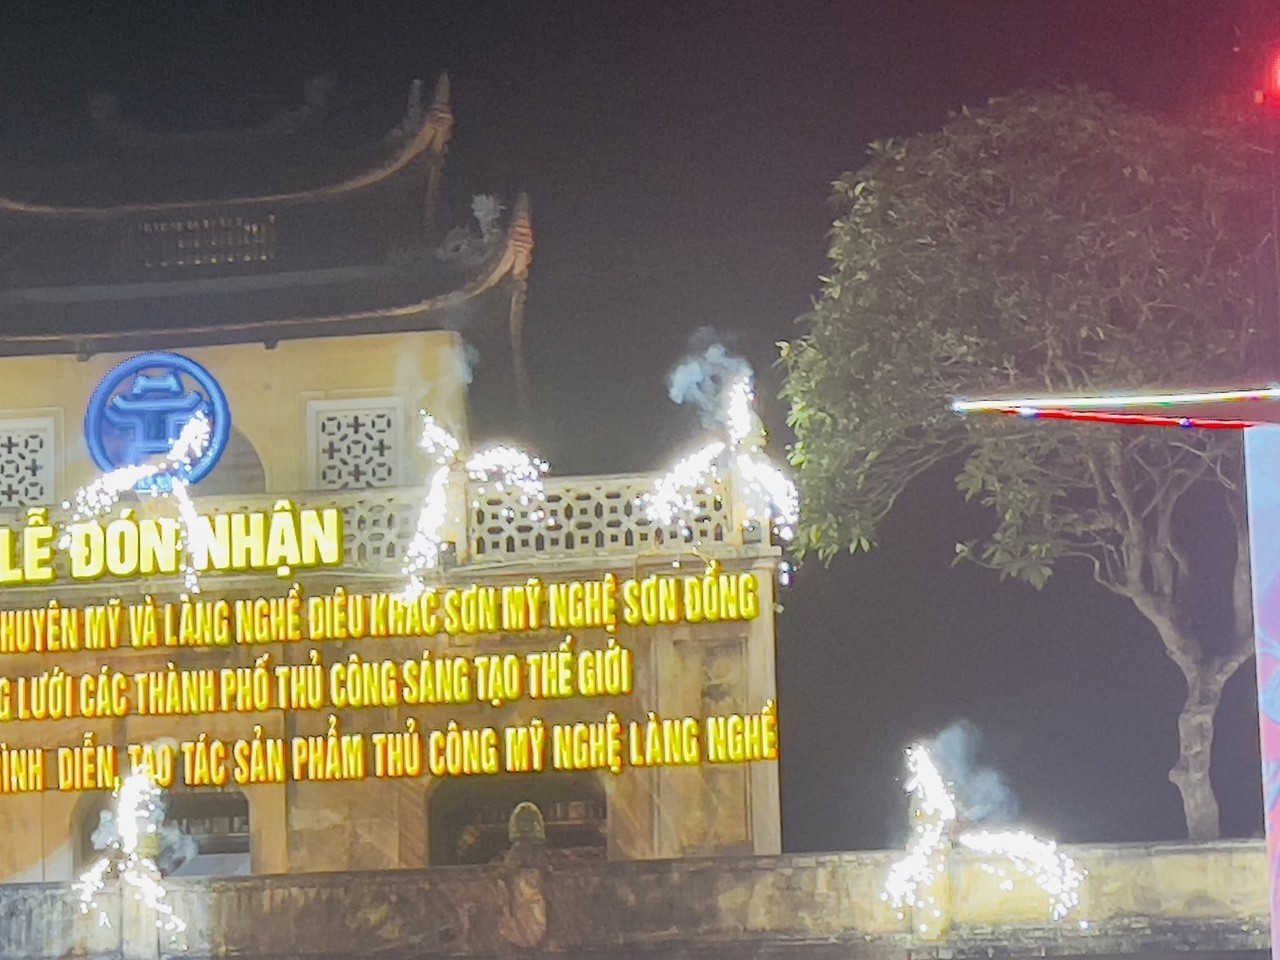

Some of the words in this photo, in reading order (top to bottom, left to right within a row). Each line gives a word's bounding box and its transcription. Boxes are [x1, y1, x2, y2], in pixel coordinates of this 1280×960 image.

[70, 508, 179, 579] ĐÓN
[193, 499, 342, 578] NHẬN
[84, 598, 121, 650] MỸ
[129, 594, 158, 649] VÀ
[164, 593, 232, 646] LÀNG
[444, 583, 497, 635] SƠN
[501, 577, 541, 631] MỸ
[549, 573, 617, 633] NGHỆ
[623, 574, 679, 626] SƠN
[18, 665, 73, 720] LƯỚI
[80, 665, 127, 720] CÁC
[134, 661, 215, 716] THÀNH
[220, 652, 270, 712] PHỐ
[275, 649, 323, 710] THỦ
[330, 654, 397, 708] CÔNG
[402, 650, 469, 704] SÁNG
[474, 654, 521, 707] TẠO
[526, 634, 573, 699] THẾ
[578, 638, 633, 696] GIỚI
[58, 732, 120, 798] DIỄN,
[181, 733, 226, 786] TÁC
[233, 725, 285, 784] SẢN
[292, 713, 364, 781] PHẨM
[372, 717, 420, 777] THỦ
[429, 720, 499, 776] CÔNG
[505, 718, 545, 773] MỸ
[553, 712, 621, 775] NGHỆ
[629, 711, 700, 767] LÀNG
[707, 698, 777, 763] NGHỀ
